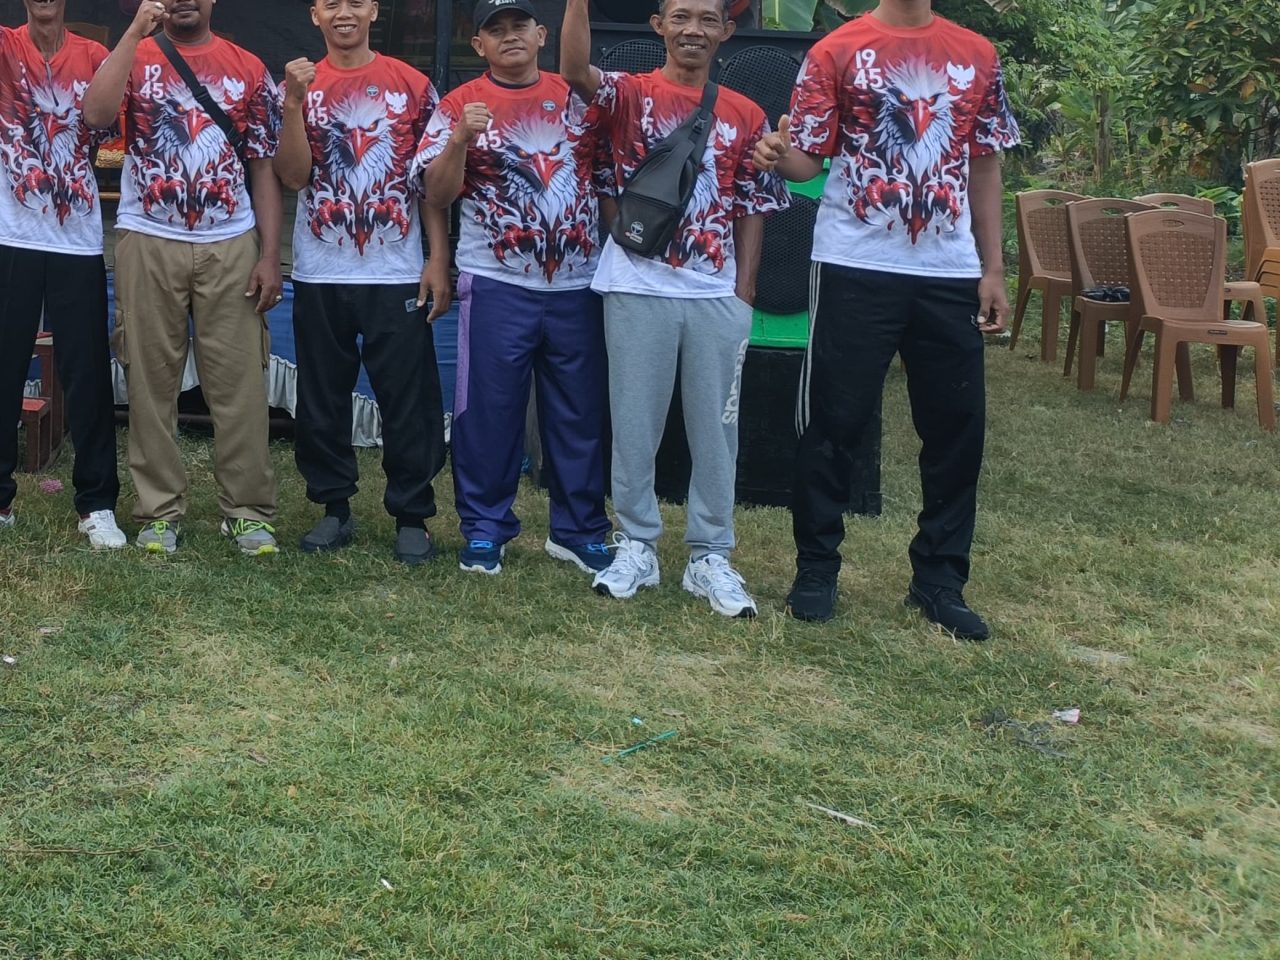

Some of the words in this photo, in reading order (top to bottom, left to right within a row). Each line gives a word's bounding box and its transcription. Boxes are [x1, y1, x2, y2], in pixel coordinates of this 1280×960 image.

[855, 48, 876, 69] 19
[145, 64, 162, 82] 19
[853, 68, 884, 89] 45
[139, 81, 164, 100] 45
[307, 90, 324, 108] 19
[307, 107, 328, 126] 45
[476, 129, 502, 150] 45
